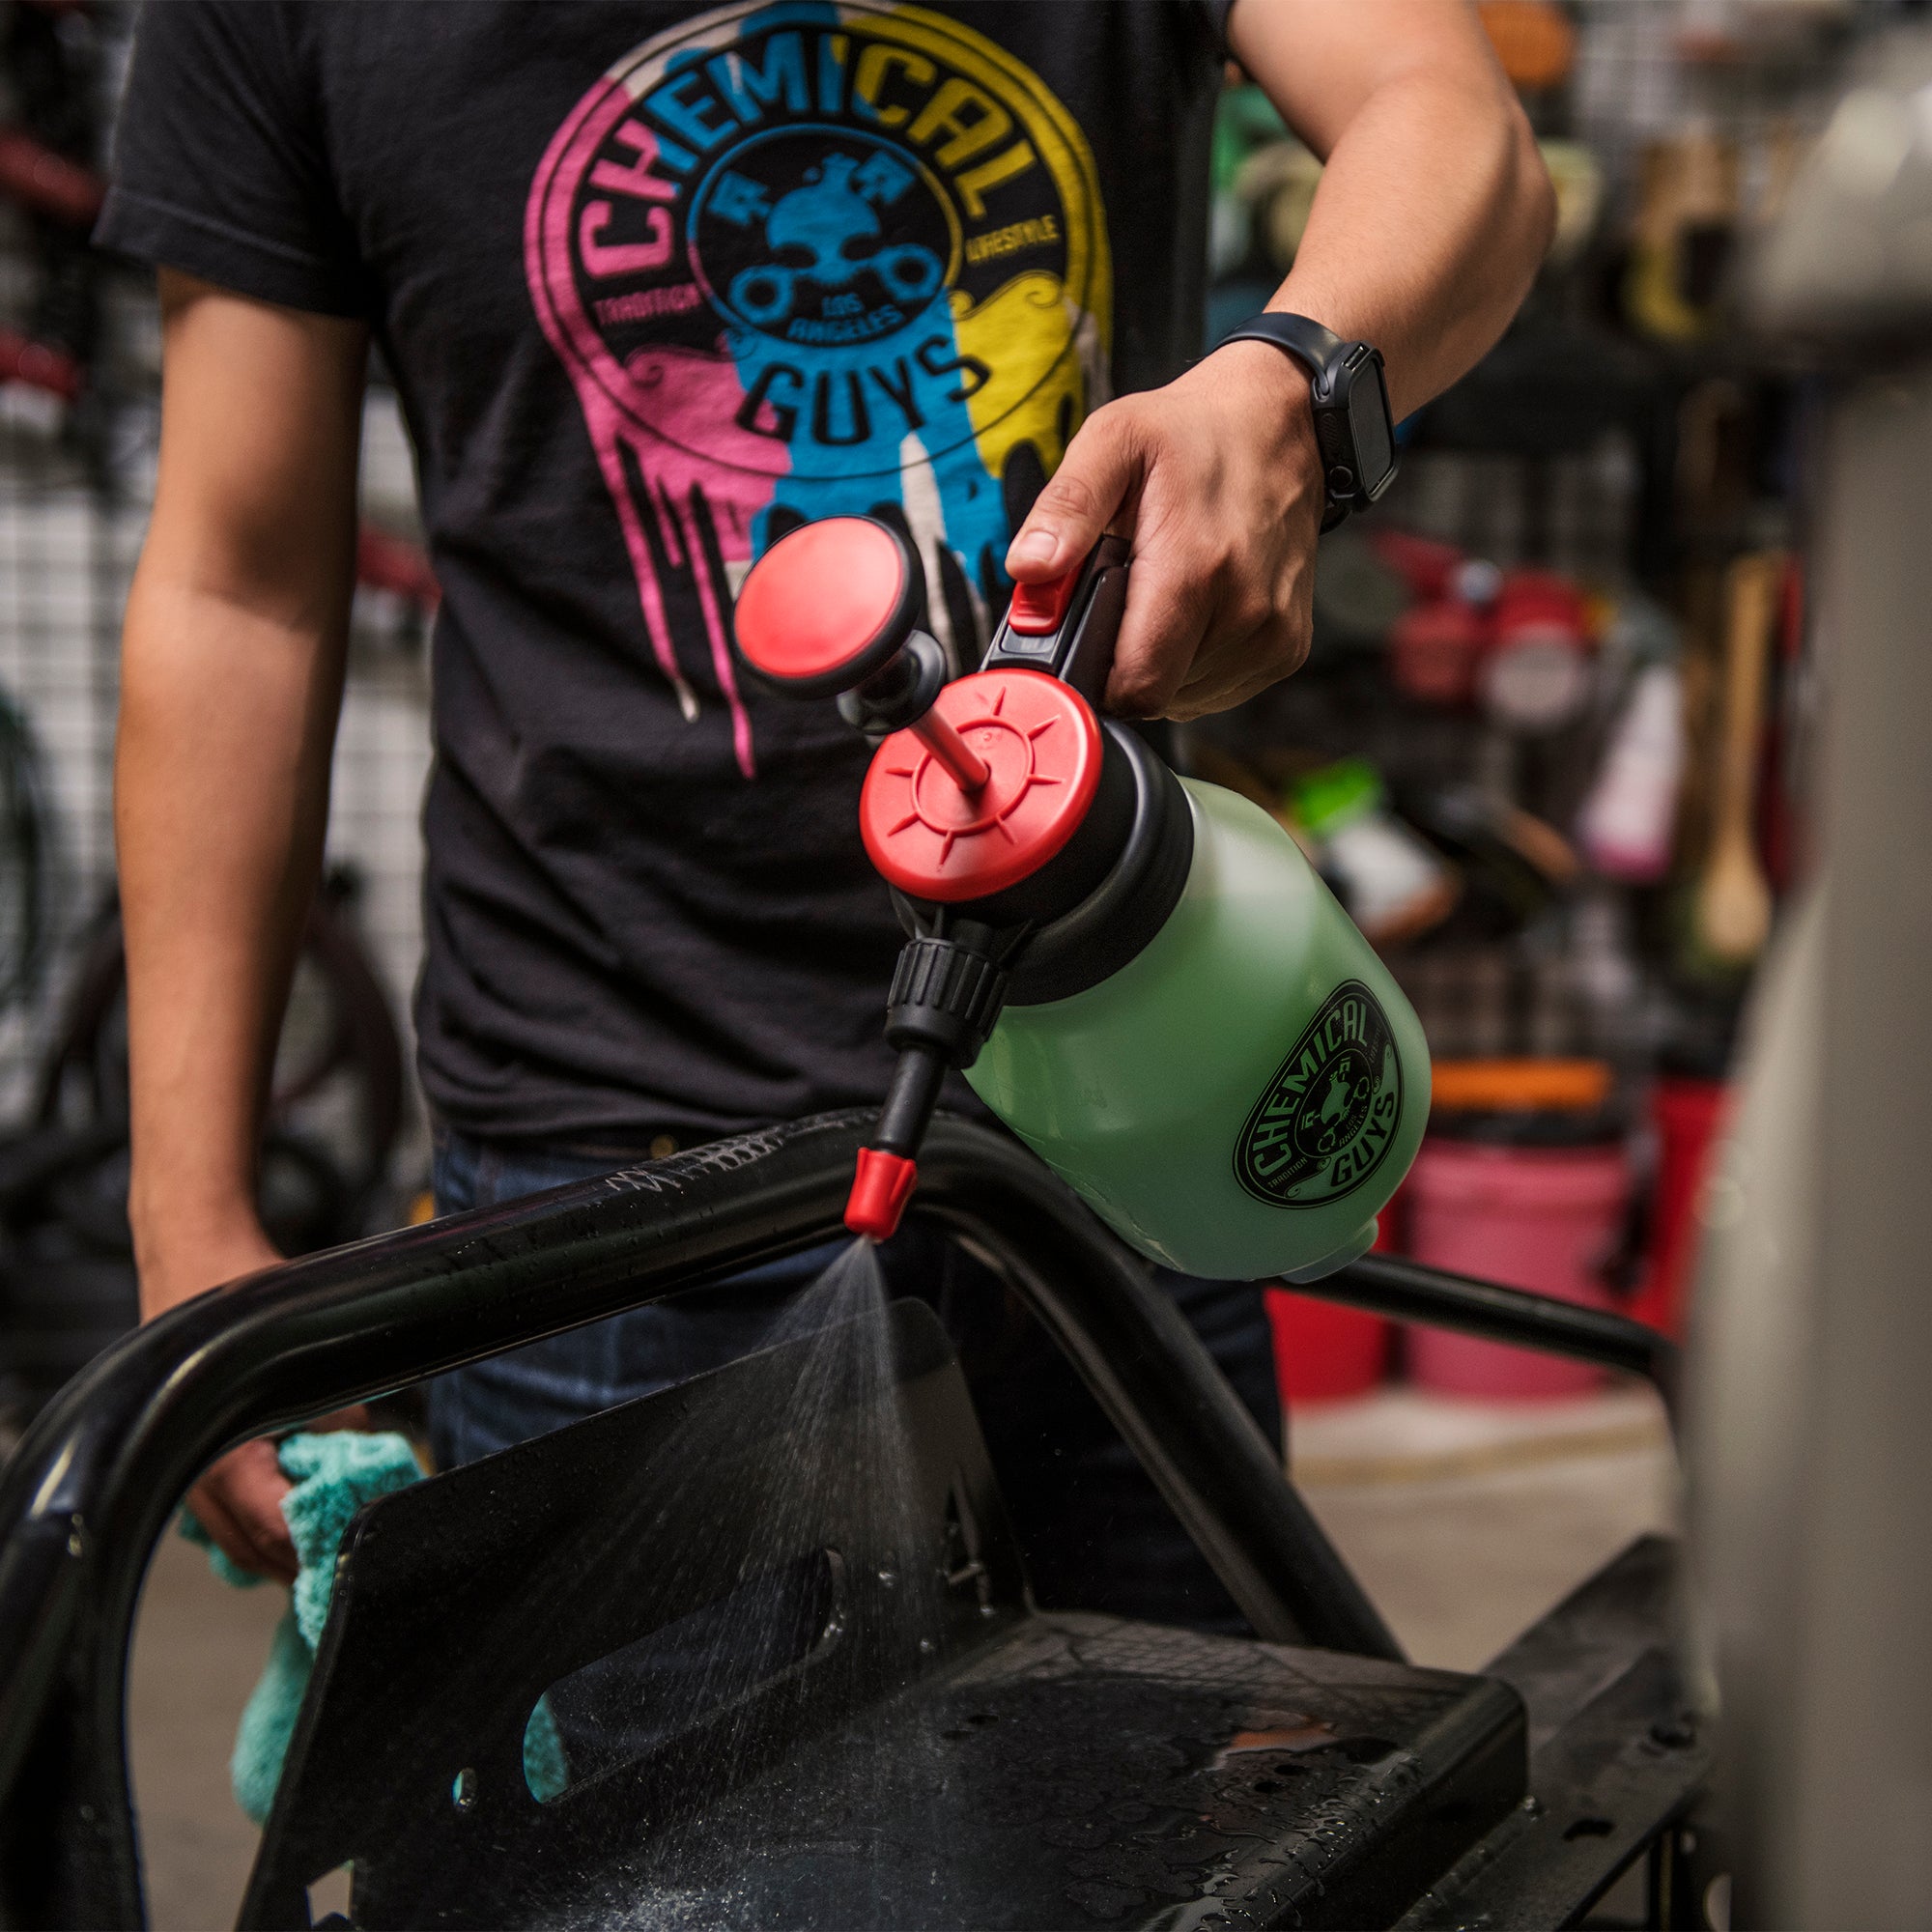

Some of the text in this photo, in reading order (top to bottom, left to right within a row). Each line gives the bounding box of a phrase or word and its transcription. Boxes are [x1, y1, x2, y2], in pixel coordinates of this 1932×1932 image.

[580, 31, 1037, 280] CHEMICAL
[734, 333, 993, 445] GUYS
[1253, 999, 1368, 1177] CHEMICAL
[1329, 1092, 1395, 1188] GUYS
[1267, 1156, 1308, 1188] TRADITION
